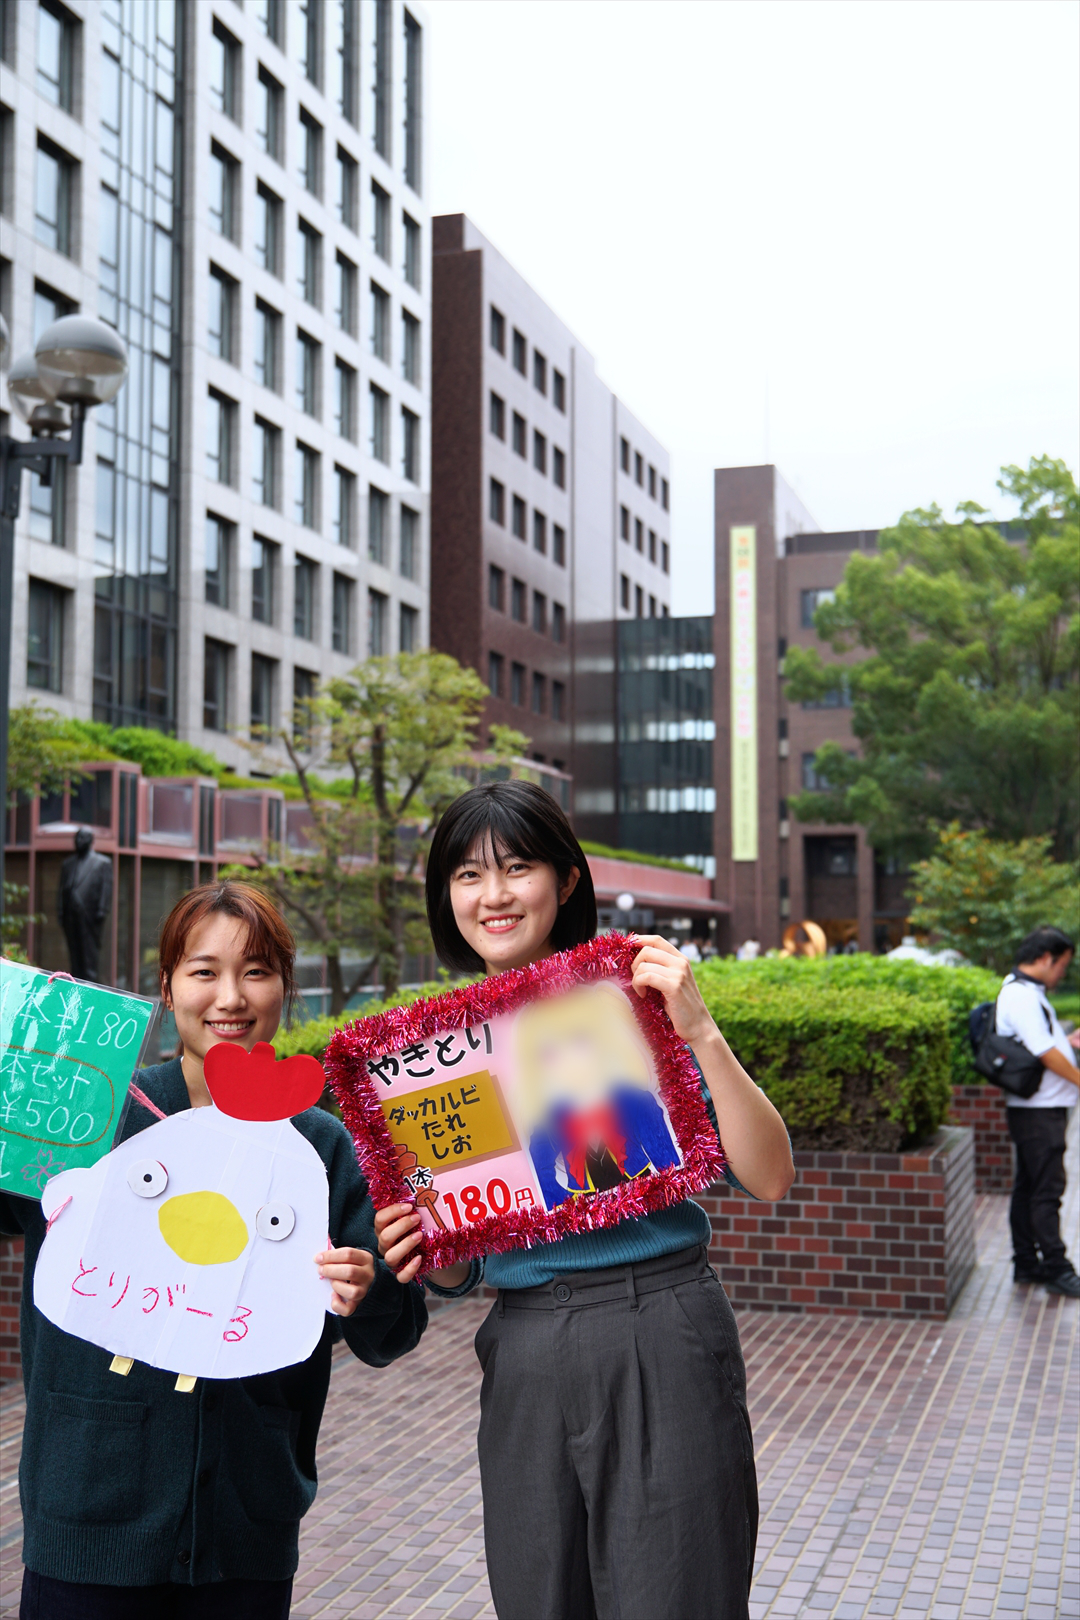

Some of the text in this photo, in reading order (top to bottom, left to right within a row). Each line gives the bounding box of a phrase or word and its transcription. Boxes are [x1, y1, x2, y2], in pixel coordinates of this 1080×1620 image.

[366, 1023, 493, 1087] やきとり
[0, 1090, 94, 1142] ¥500
[388, 1084, 481, 1126] ダッカルビ
[420, 1113, 467, 1141] たれ
[431, 1134, 472, 1160] しお
[402, 1167, 433, 1195] 1本
[71, 1256, 253, 1343] とりがーる
